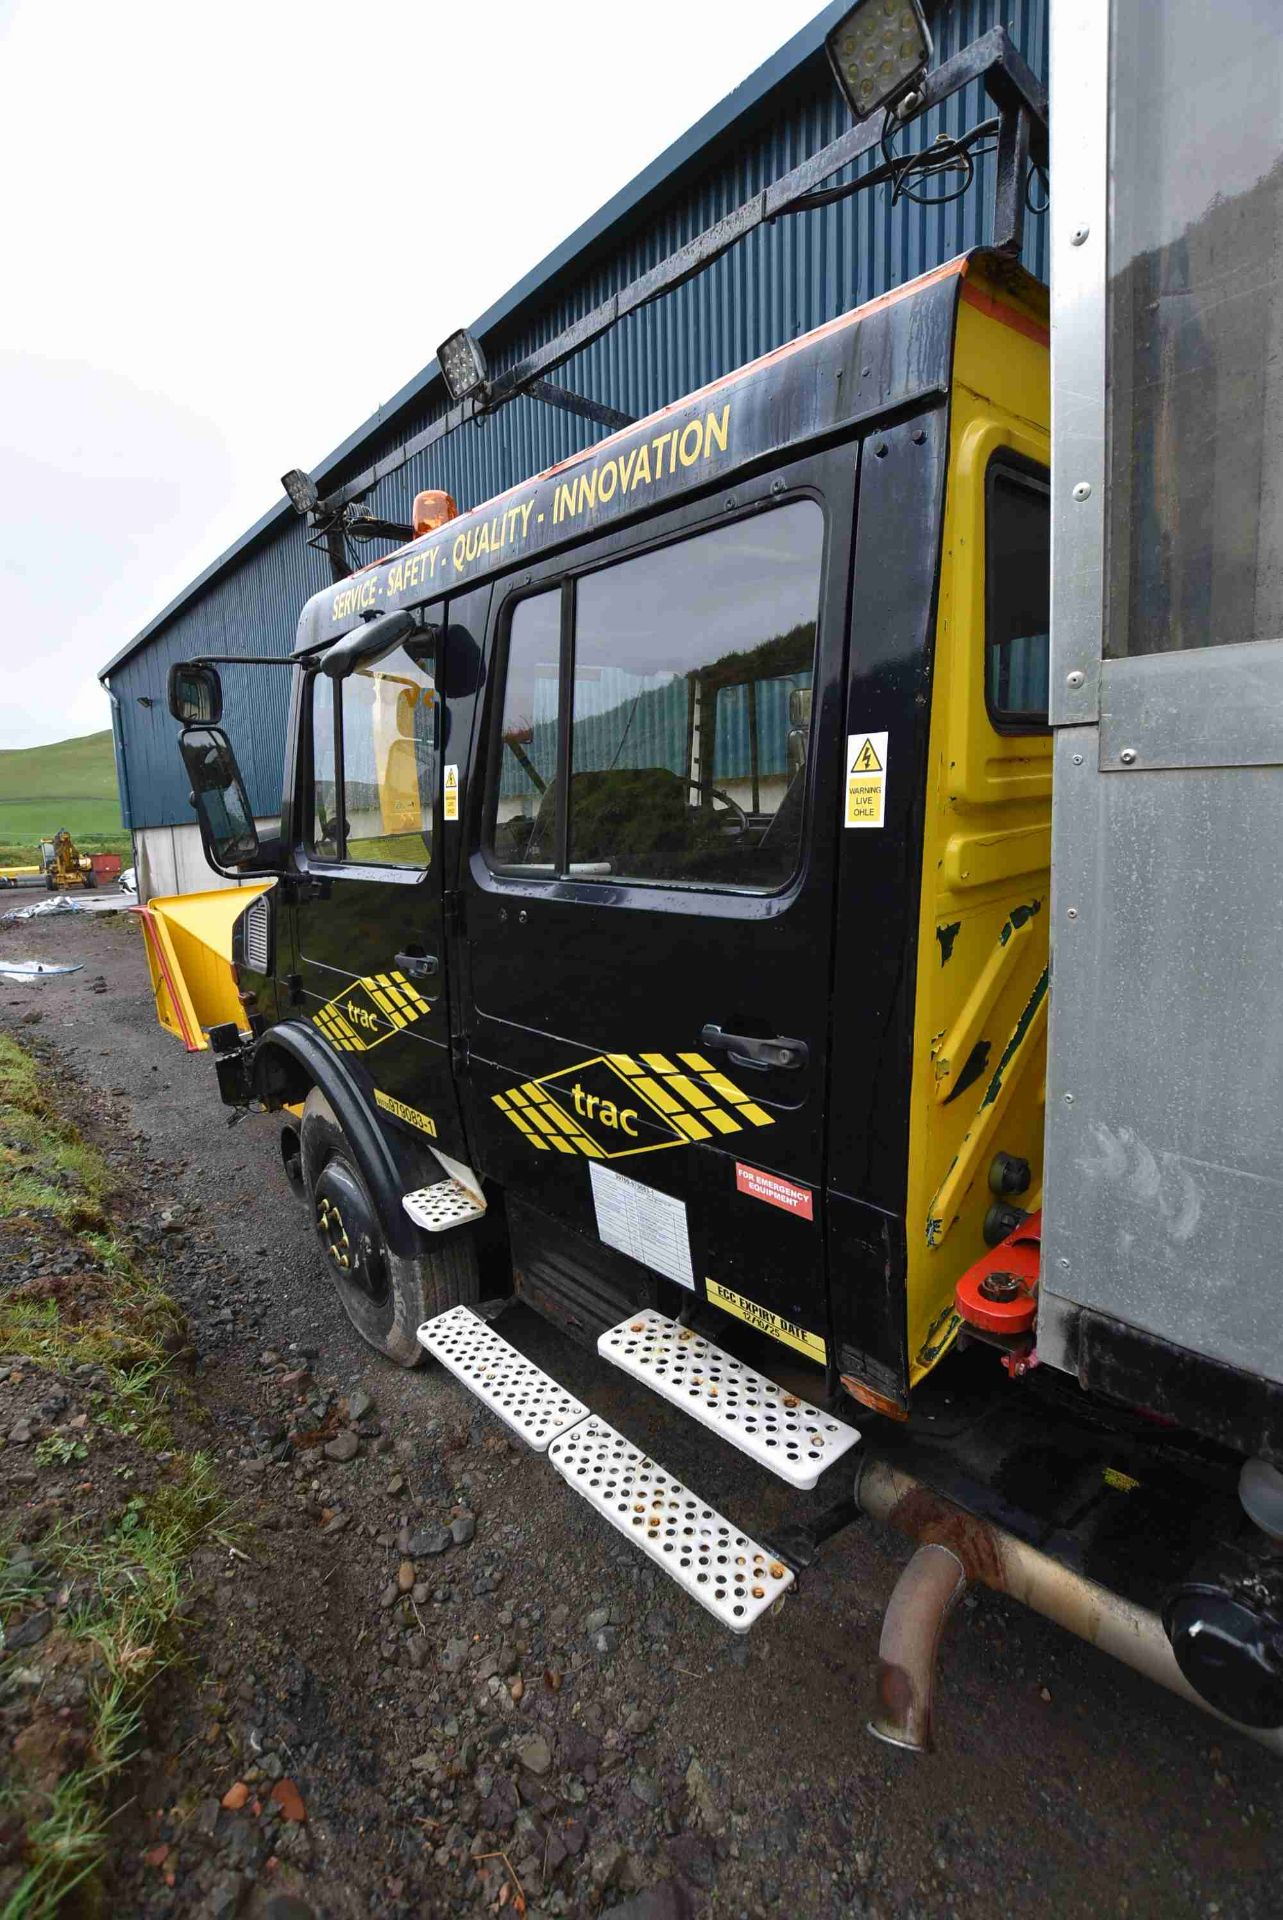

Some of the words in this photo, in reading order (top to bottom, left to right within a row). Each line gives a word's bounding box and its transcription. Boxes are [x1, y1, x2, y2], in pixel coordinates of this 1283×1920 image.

[332, 576, 378, 621] SERVICE
[387, 546, 439, 597] SAFETY
[453, 500, 535, 572] QUALITY
[552, 404, 731, 524] INNOVATION
[849, 786, 882, 795] WARNING
[855, 797, 873, 805] LIVE
[853, 808, 875, 817] OHLE
[347, 1000, 378, 1031] trac
[571, 1083, 638, 1137] trac
[738, 1169, 755, 1182] FOR
[755, 1176, 810, 1203] EMERGENCY
[748, 1181, 799, 1208] EQUIPMENT
[717, 1285, 737, 1304] ECC
[739, 1297, 776, 1325] EXPIRY
[780, 1319, 808, 1342] DATE
